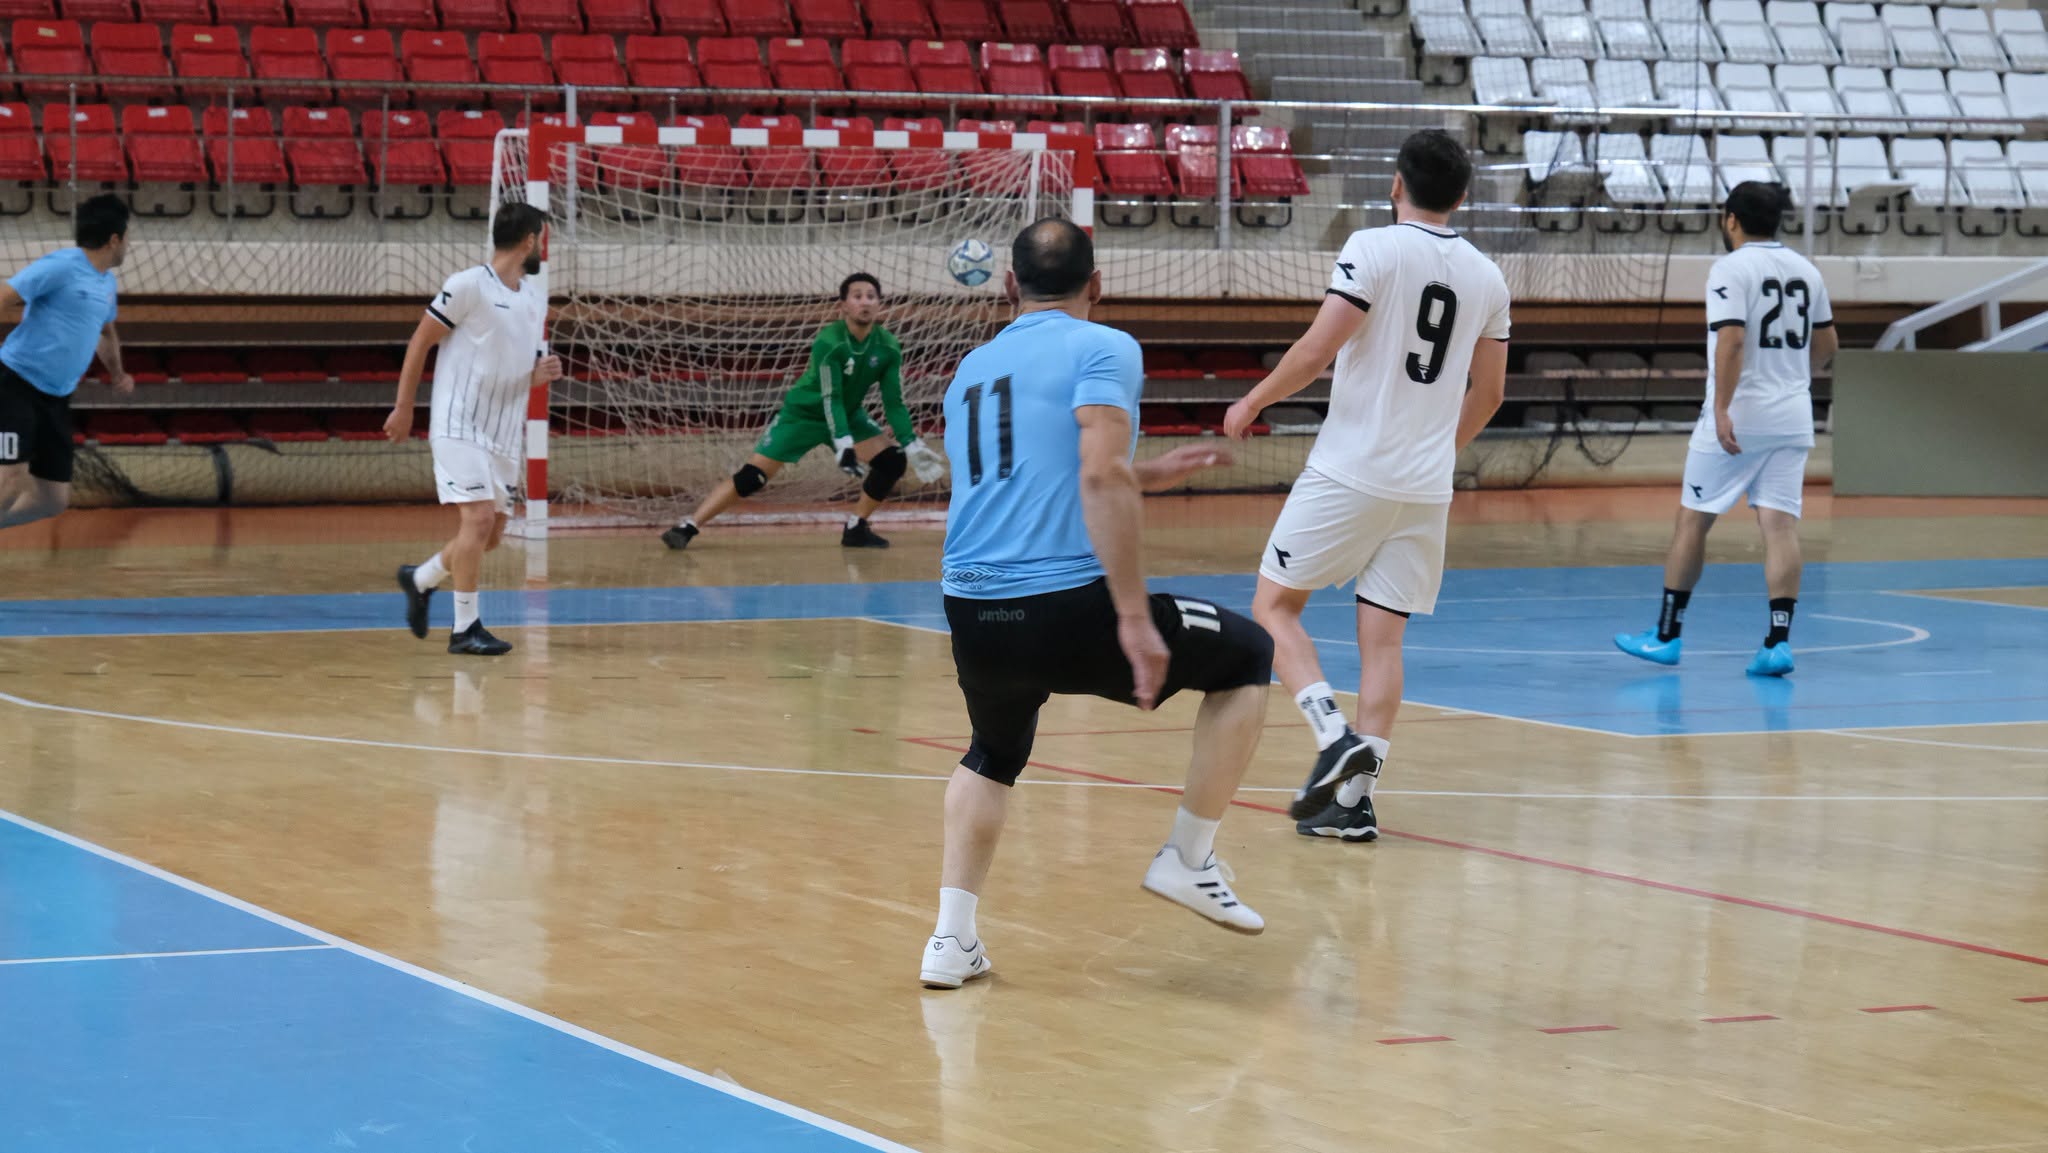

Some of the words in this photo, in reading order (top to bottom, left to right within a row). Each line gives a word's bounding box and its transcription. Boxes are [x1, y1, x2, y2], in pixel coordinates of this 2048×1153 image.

[1405, 281, 1459, 384] 9
[1759, 277, 1810, 350] 23
[961, 373, 1014, 487] 11
[978, 607, 1025, 622] umbro
[1174, 599, 1221, 633] 11
